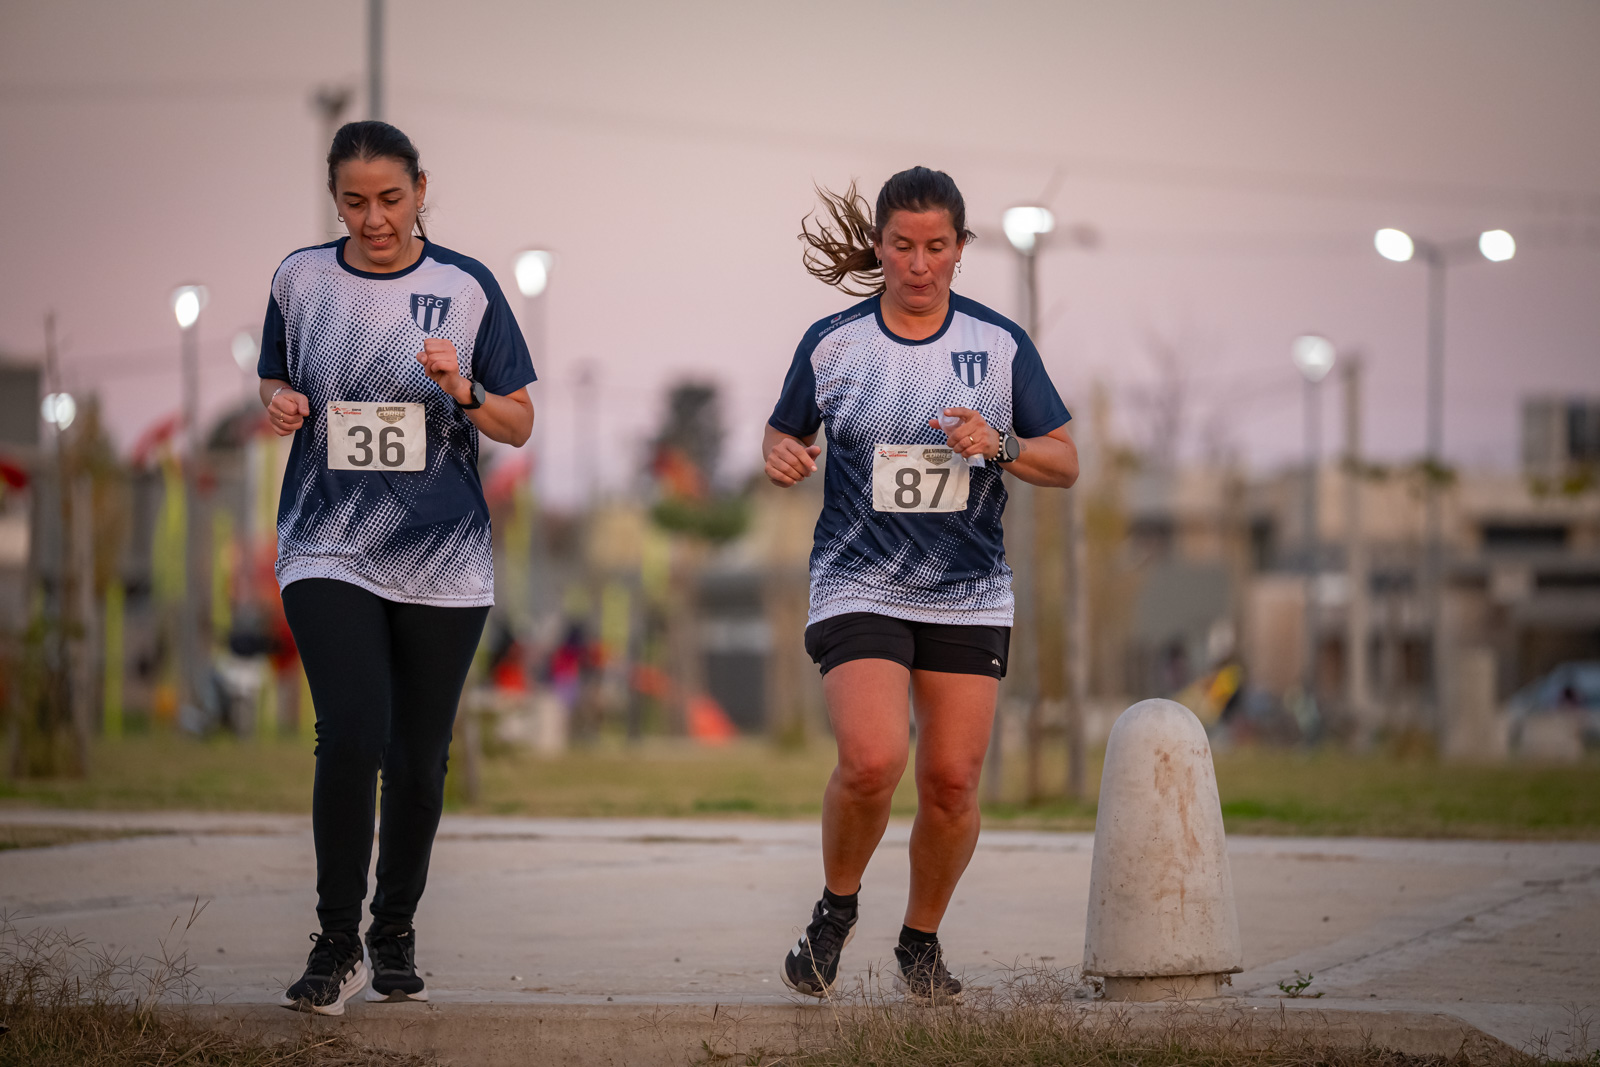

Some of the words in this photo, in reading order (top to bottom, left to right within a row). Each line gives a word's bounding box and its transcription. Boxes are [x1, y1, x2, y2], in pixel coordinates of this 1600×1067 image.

[417, 296, 444, 308] SFC
[958, 354, 982, 362] SFC
[347, 425, 406, 467] 36
[894, 467, 951, 509] 87
